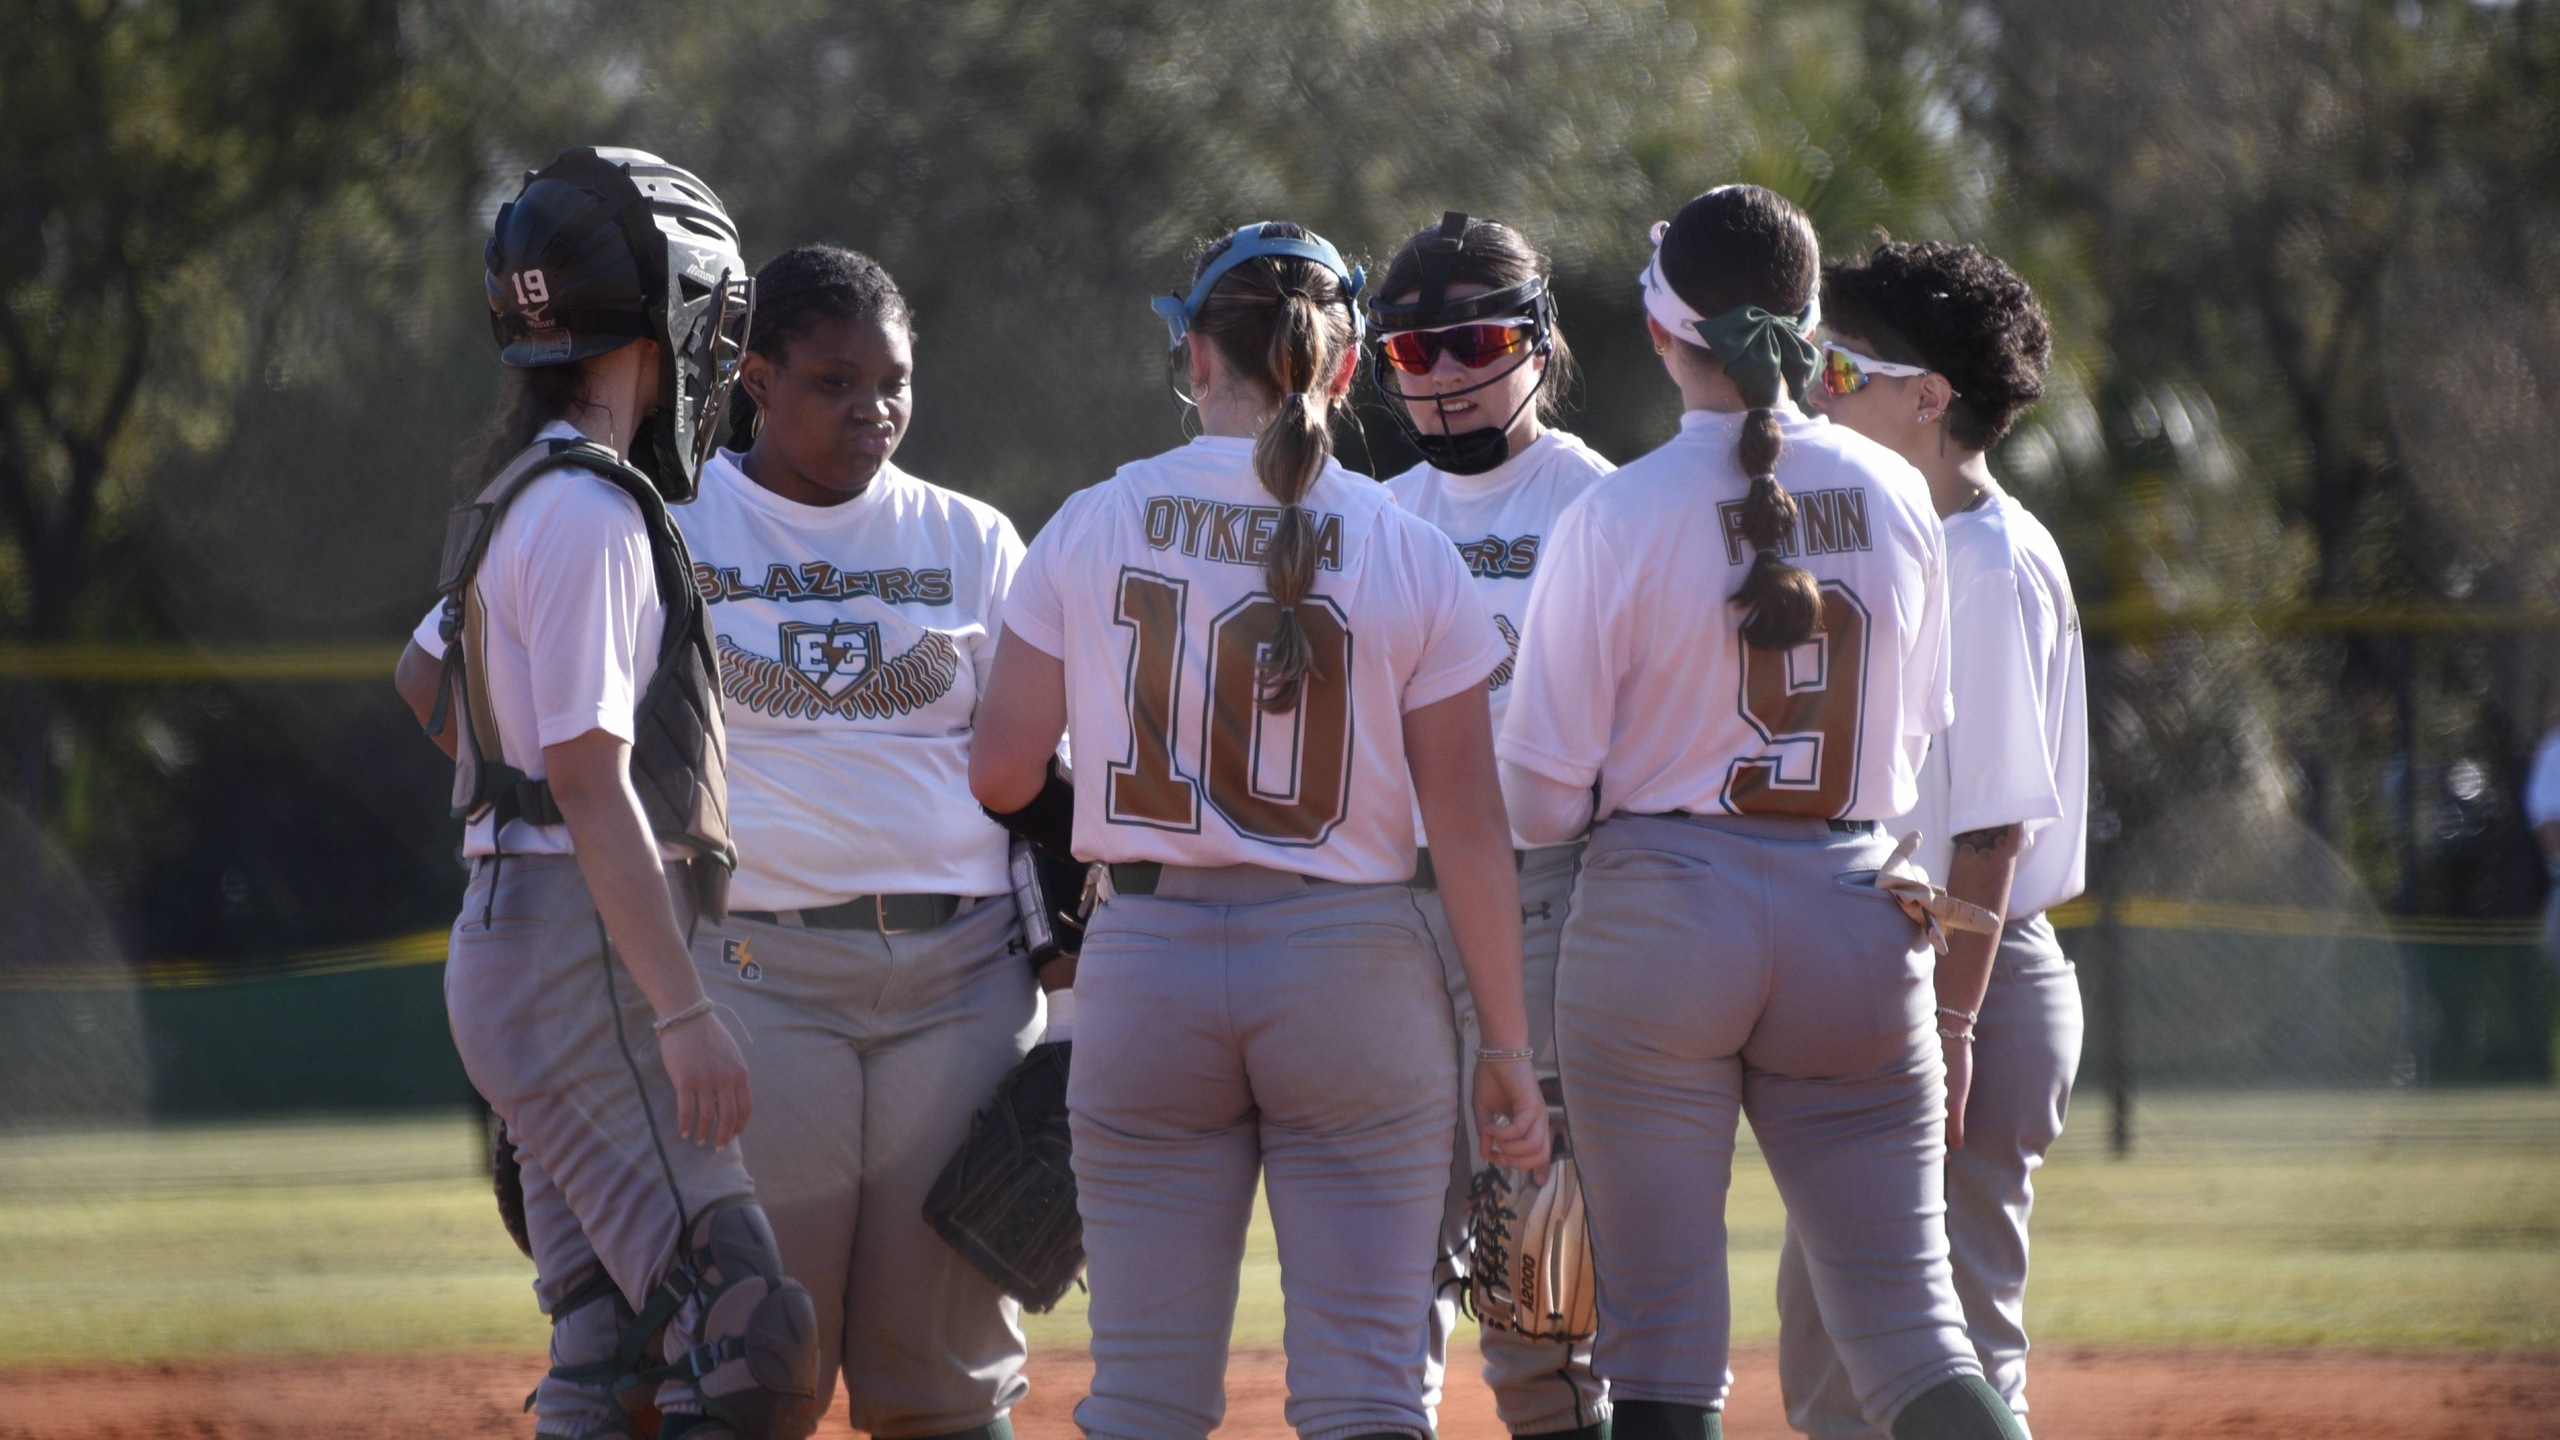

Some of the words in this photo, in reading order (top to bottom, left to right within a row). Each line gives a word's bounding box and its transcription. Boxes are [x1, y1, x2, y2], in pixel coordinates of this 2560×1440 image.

[511, 268, 550, 305] 19
[677, 356, 685, 433] SAMURAI
[1143, 495, 1344, 572] OYKEA
[1716, 487, 1873, 566] FNN
[694, 560, 954, 607] BLAZERS
[1105, 564, 1354, 849] 10
[1719, 579, 1872, 819] 9
[1521, 1253, 1536, 1313] A2000
